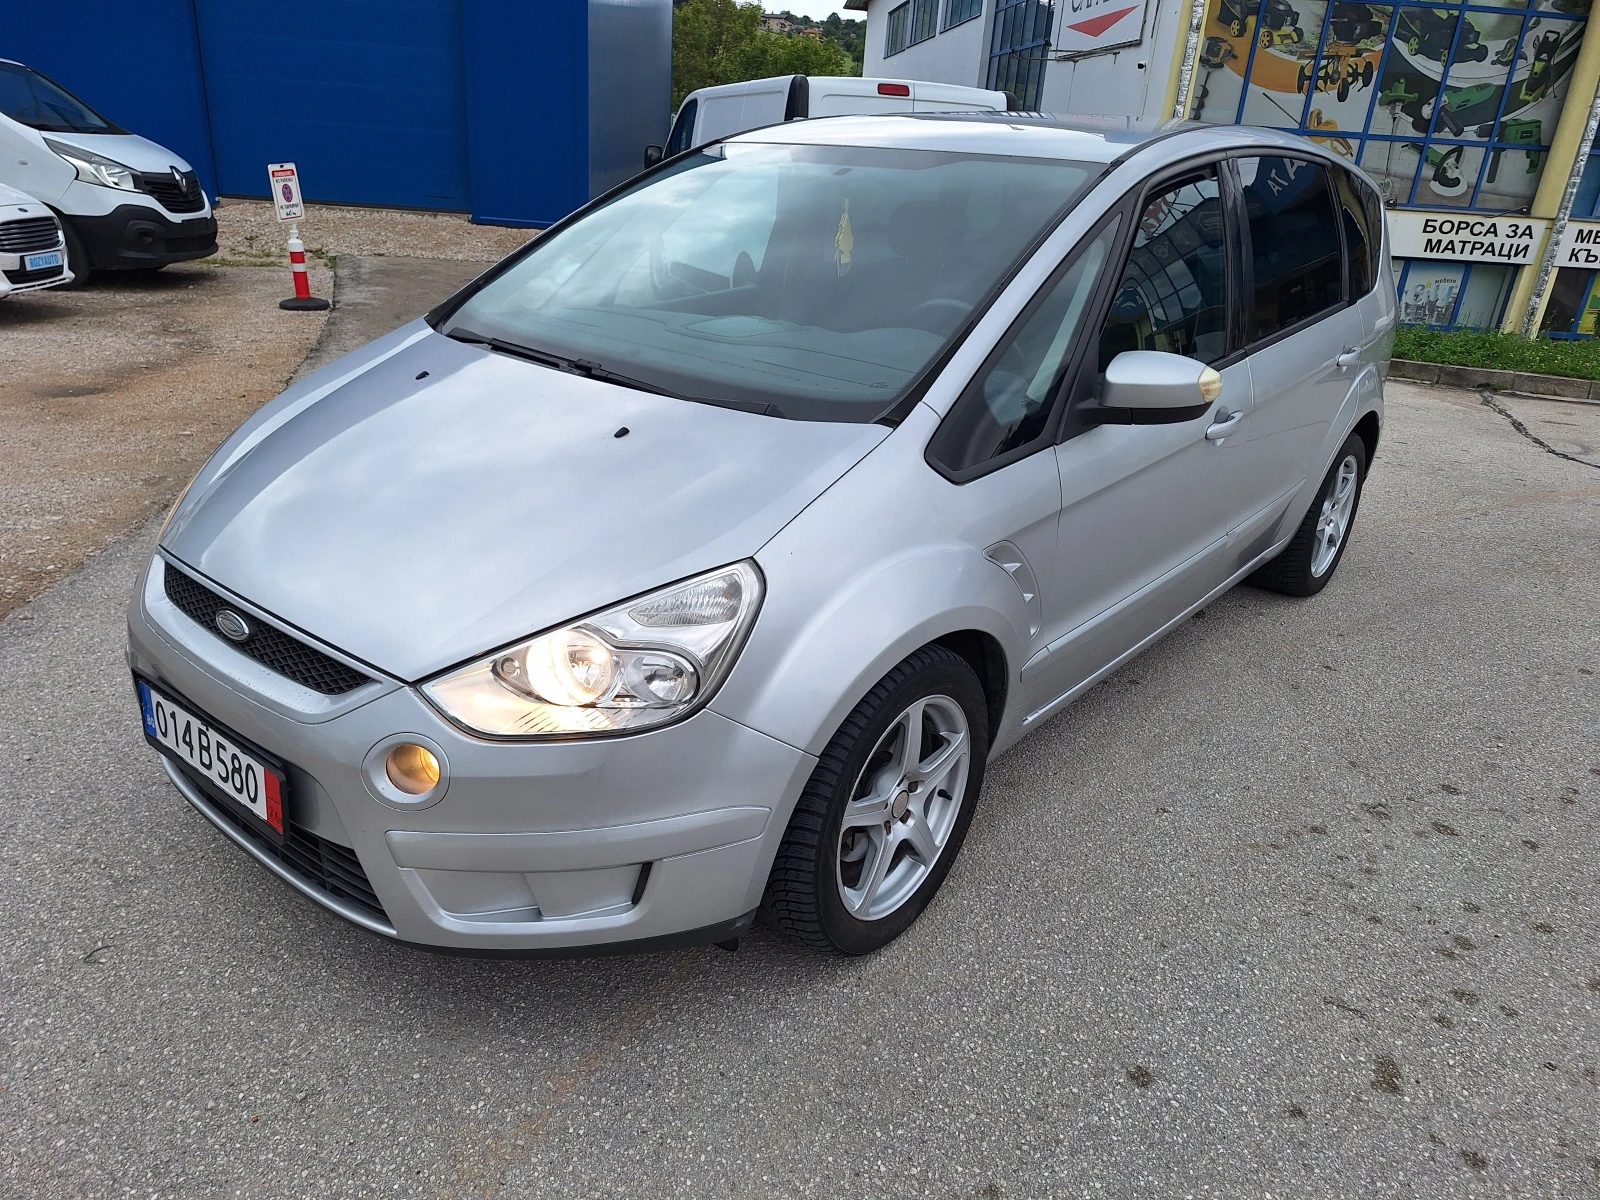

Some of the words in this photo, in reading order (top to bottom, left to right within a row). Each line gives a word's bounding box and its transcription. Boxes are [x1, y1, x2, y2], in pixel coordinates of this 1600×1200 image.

[1422, 218, 1499, 238] БОРСА
[1505, 223, 1534, 240] ЗА
[1423, 238, 1530, 261] МАТРАЦИ
[1568, 247, 1600, 263] КЪ
[29, 254, 59, 268] BOZYAUTO
[146, 713, 156, 728] BG
